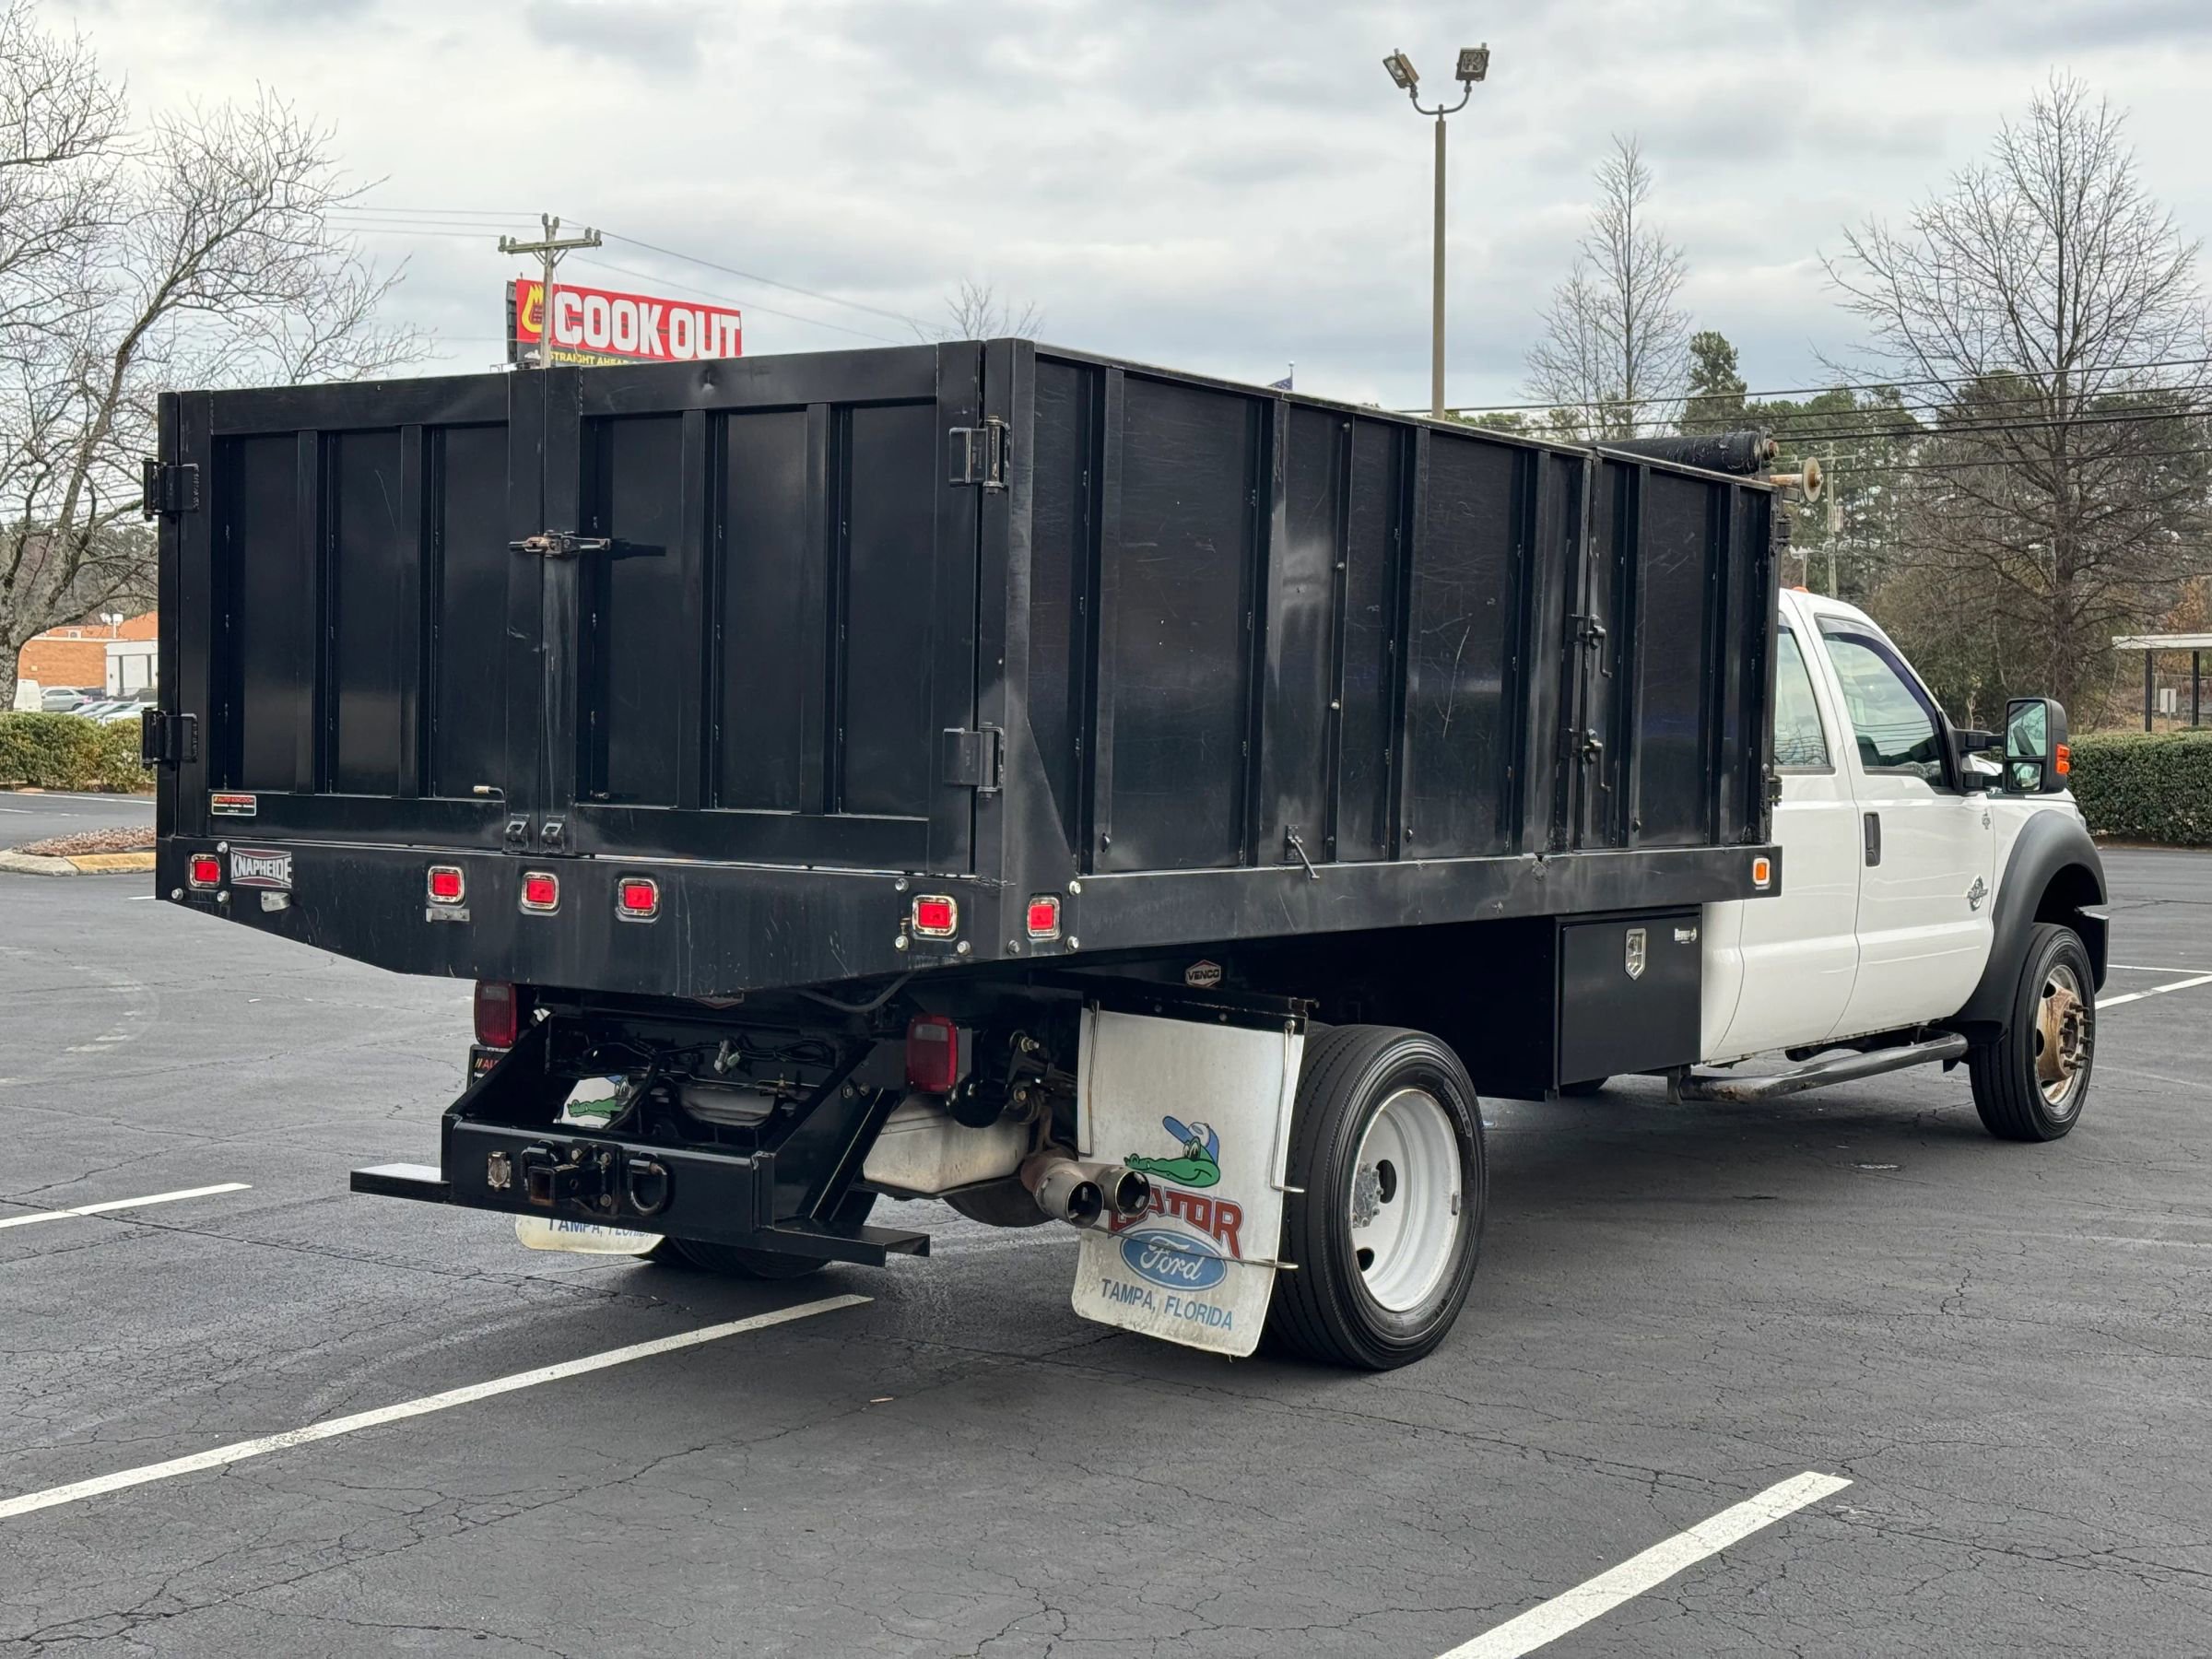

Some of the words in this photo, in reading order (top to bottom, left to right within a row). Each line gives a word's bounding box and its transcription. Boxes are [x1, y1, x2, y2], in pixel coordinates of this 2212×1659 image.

[555, 291, 665, 357] COOK
[669, 308, 743, 359] OUT
[230, 853, 292, 883] KNAPHEIDE
[1187, 970, 1219, 981] VENCO
[1140, 1236, 1204, 1282] Ford
[1101, 1278, 1157, 1313] TAMPA,
[1164, 1295, 1233, 1331] FLORIDA
